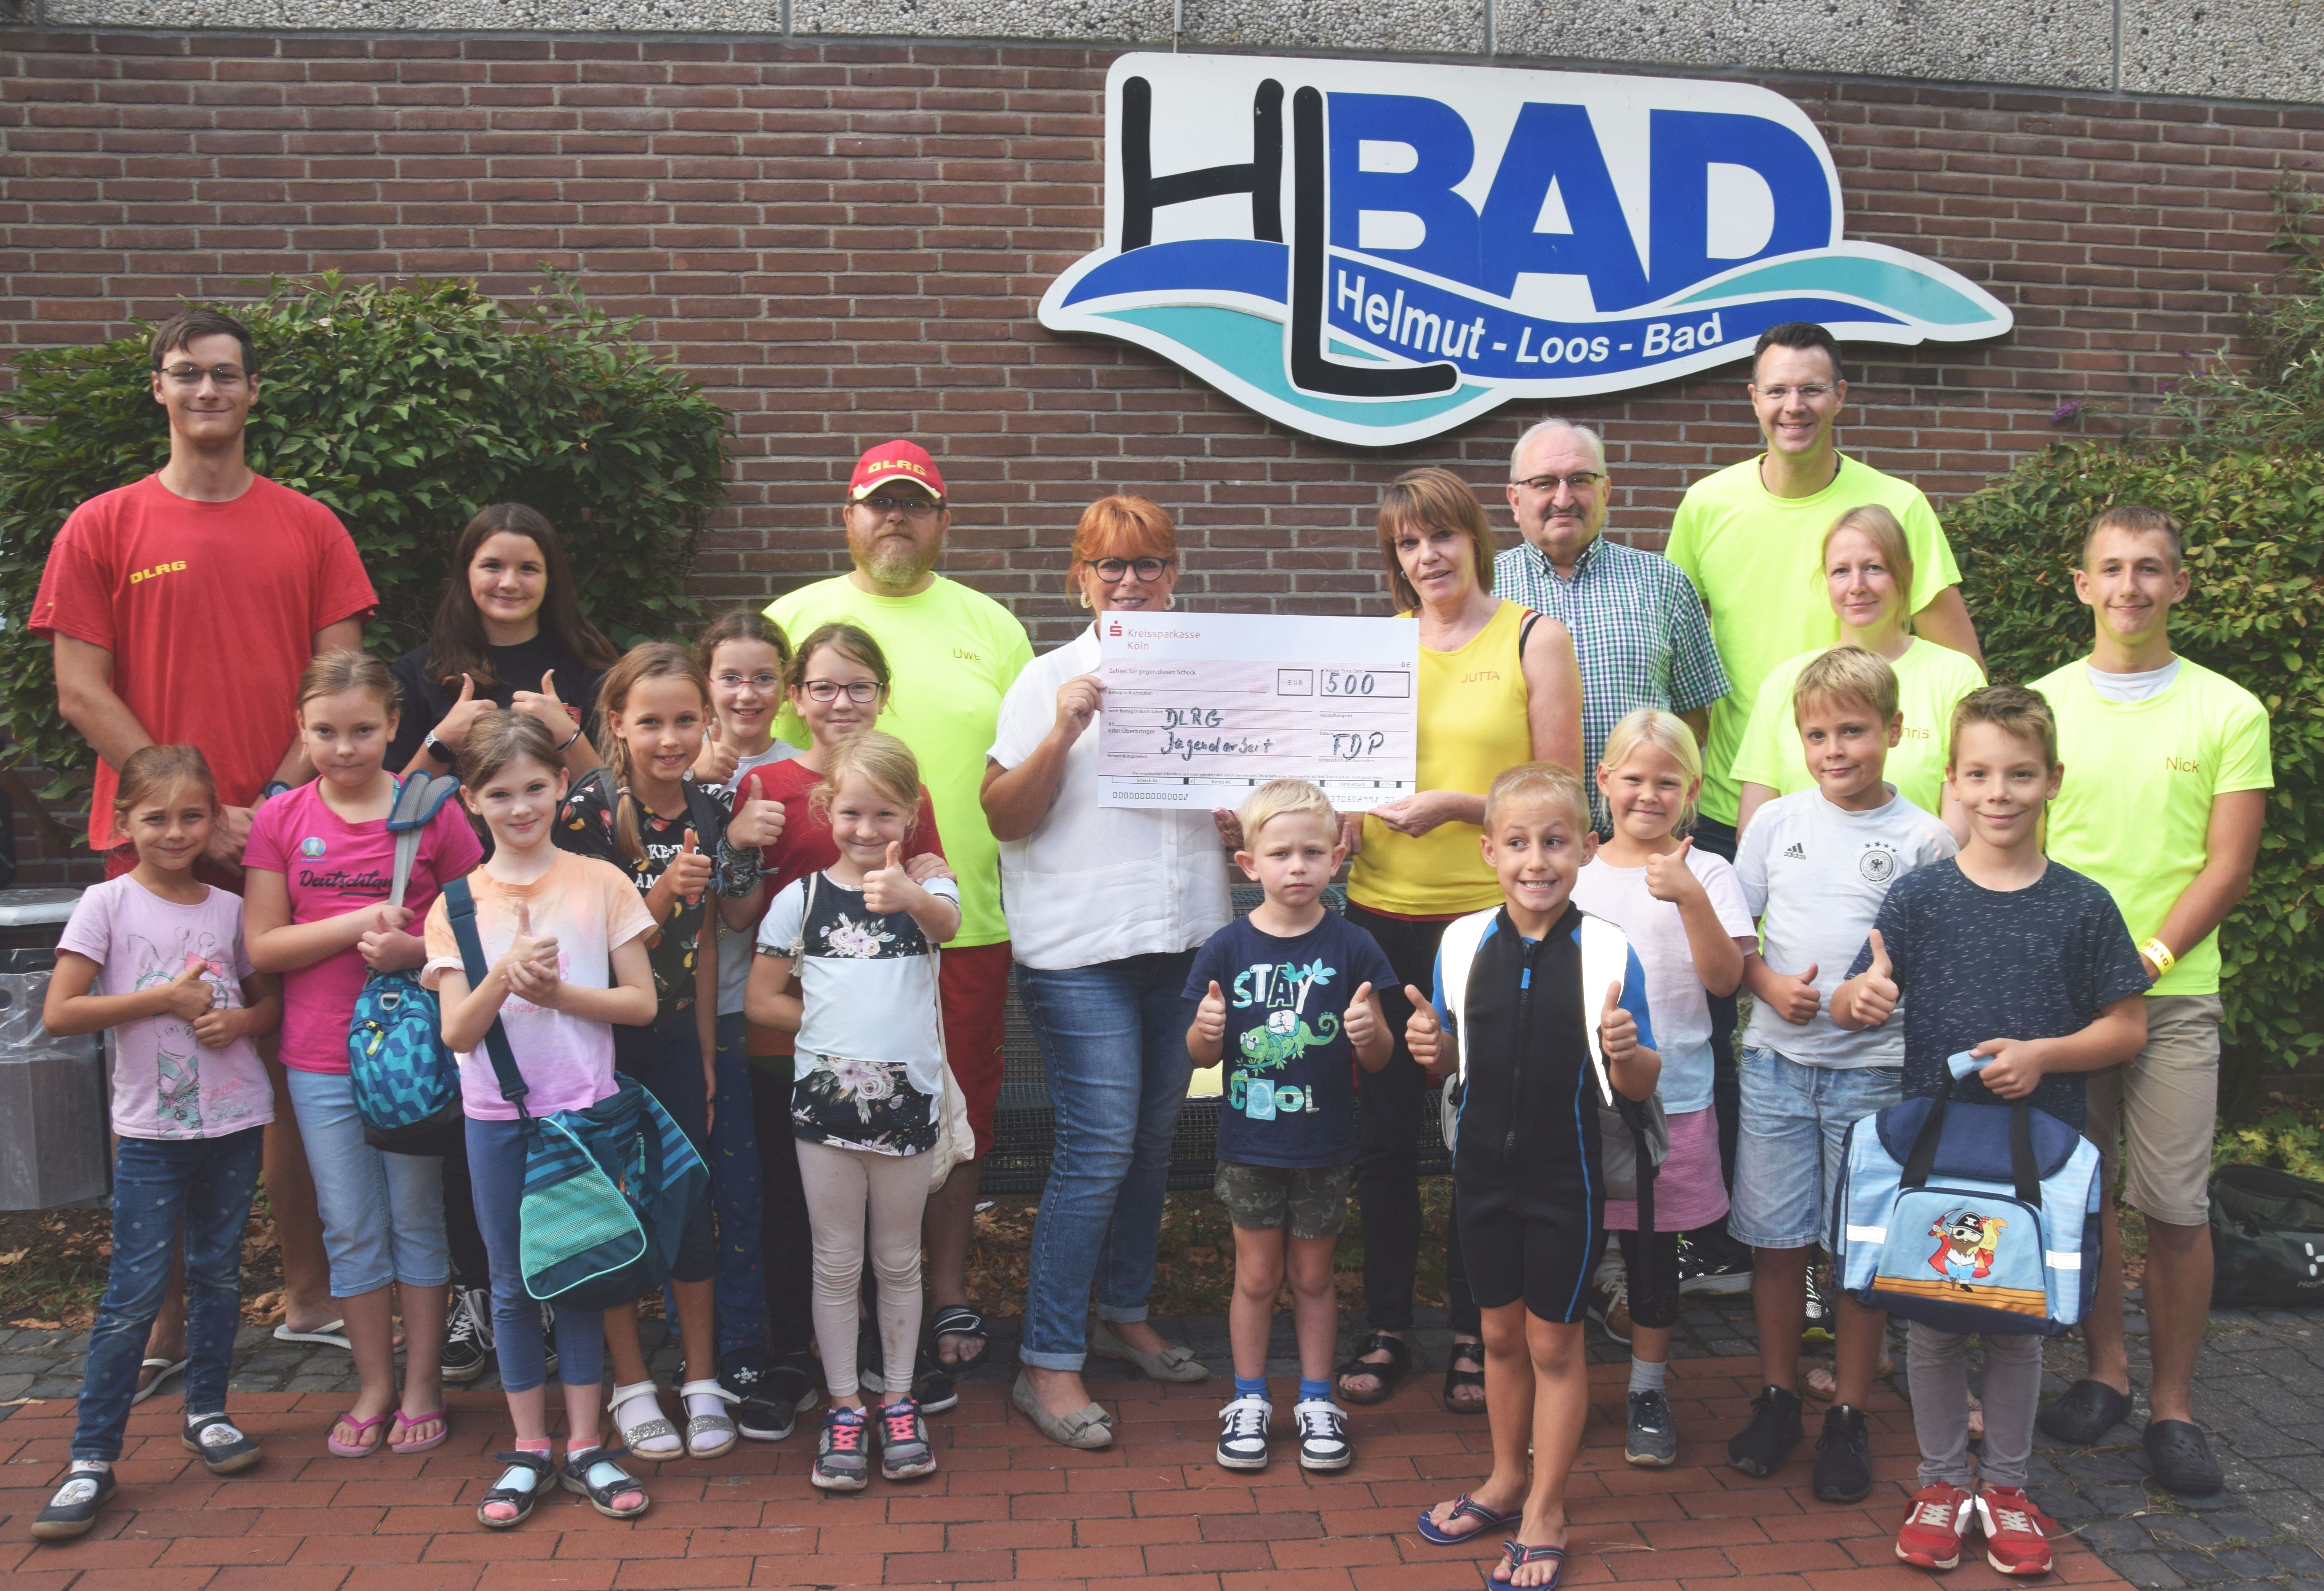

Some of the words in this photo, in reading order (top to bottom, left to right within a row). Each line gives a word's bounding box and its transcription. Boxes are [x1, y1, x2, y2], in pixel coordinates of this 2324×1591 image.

[1337, 269, 1485, 360] Helmut
[1516, 326, 1609, 364] Loos
[1641, 312, 1723, 358] Bad
[867, 459, 926, 476] DLRG
[130, 561, 187, 584] DLRG
[1128, 629, 1201, 639] Kreissparkasse
[953, 648, 981, 660] Uwe
[1127, 641, 1149, 650] Köln
[1326, 672, 1375, 695] 500
[1462, 671, 1500, 683] JUTTA
[1161, 707, 1224, 730] DLRG
[1122, 727, 1155, 735] Überbringer
[1901, 725, 1929, 739] hris
[1333, 731, 1385, 760] FDP
[2166, 756, 2200, 773] Nick
[1783, 851, 1806, 860] adidas
[1232, 963, 1322, 1014] STAY
[1230, 1077, 1321, 1121] COOL
